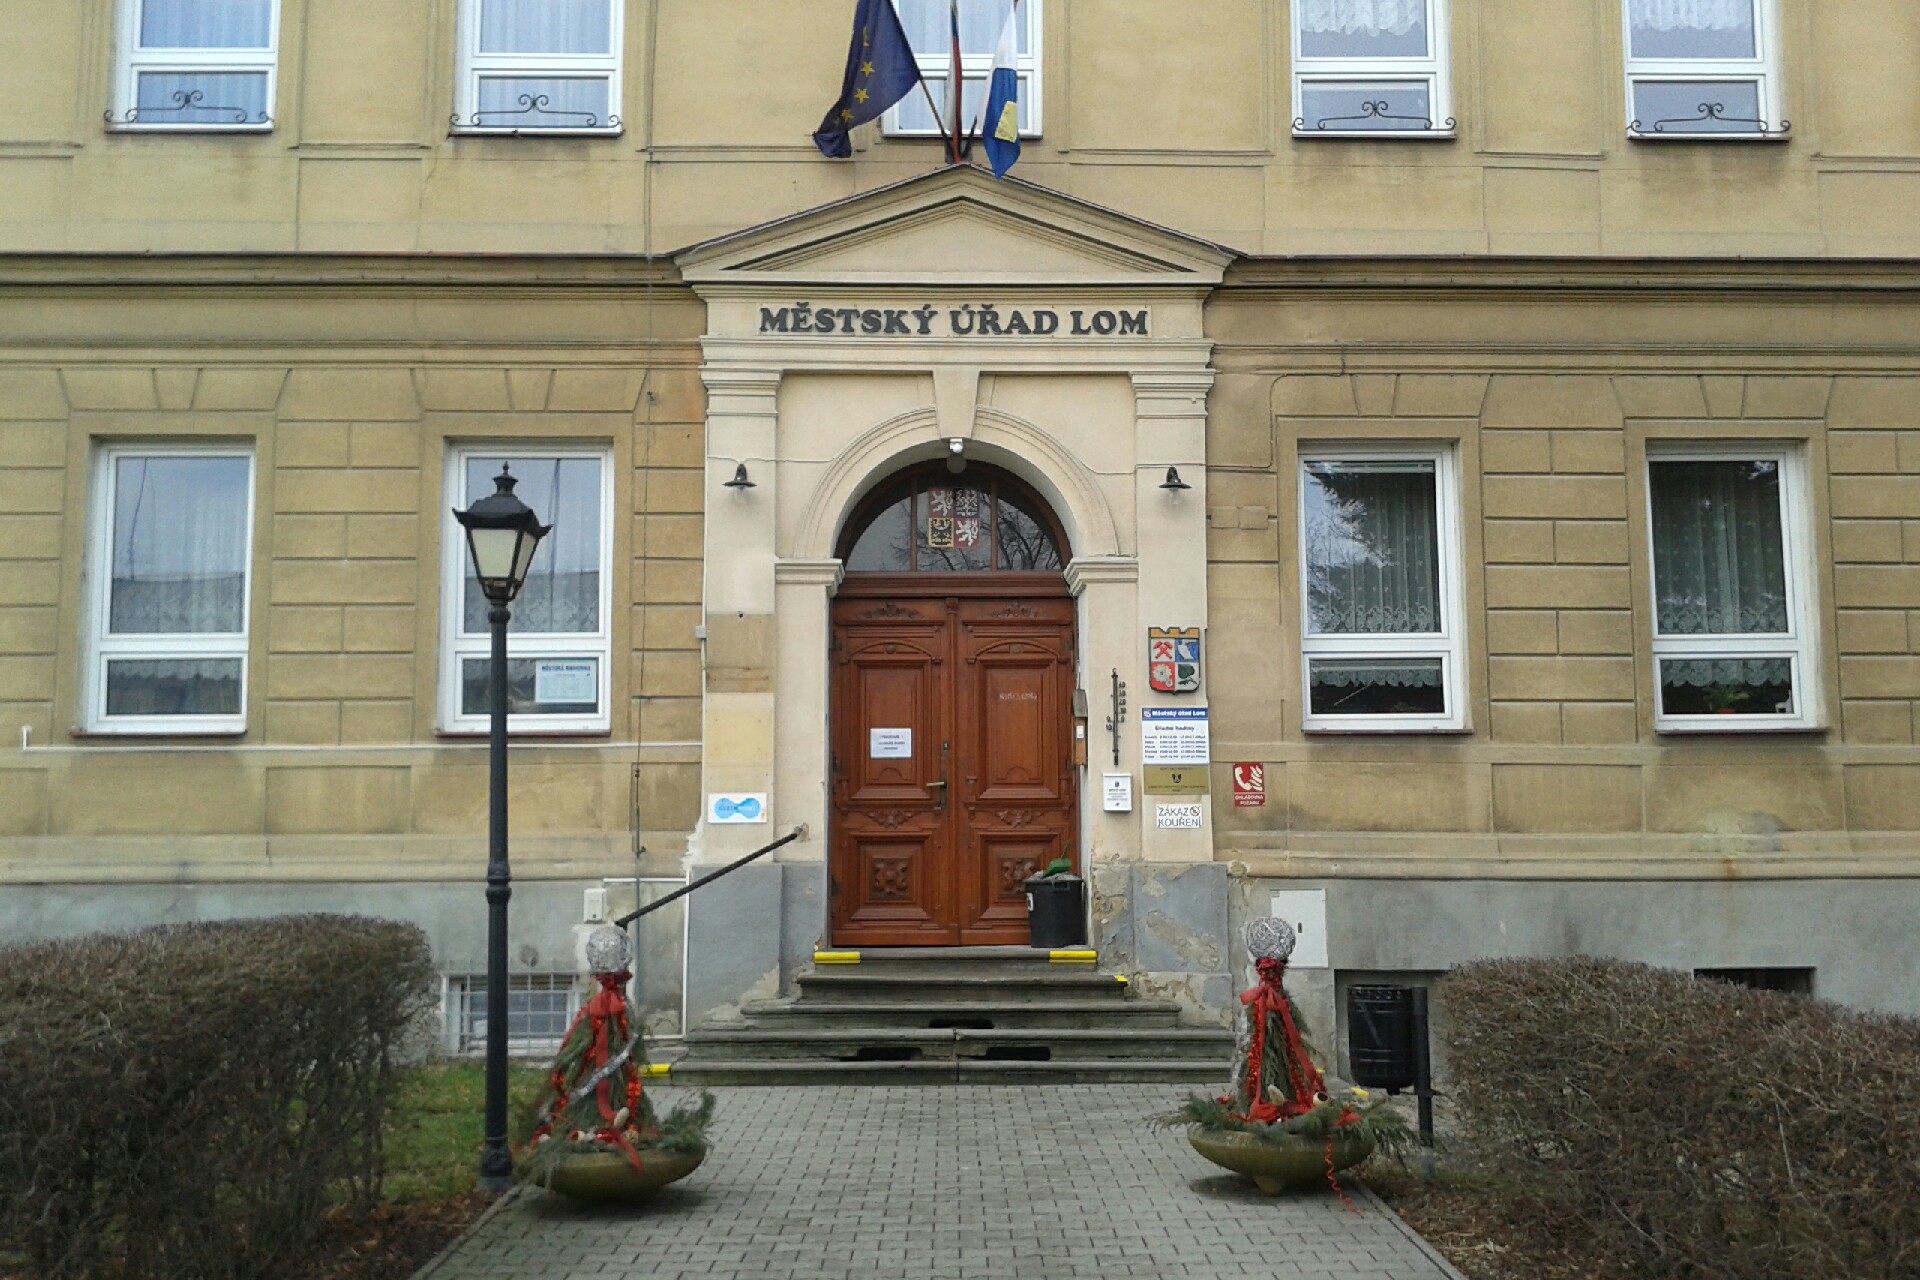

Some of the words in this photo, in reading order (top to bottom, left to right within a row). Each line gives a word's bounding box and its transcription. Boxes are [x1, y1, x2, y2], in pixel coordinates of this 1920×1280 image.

[760, 302, 938, 334] MĚSTSKÝ
[949, 303, 1058, 335] ÚŘAD
[1070, 310, 1149, 335] LOM
[1158, 805, 1189, 816] ZÁKAZ
[1158, 815, 1201, 827] KOUŘENÍ
